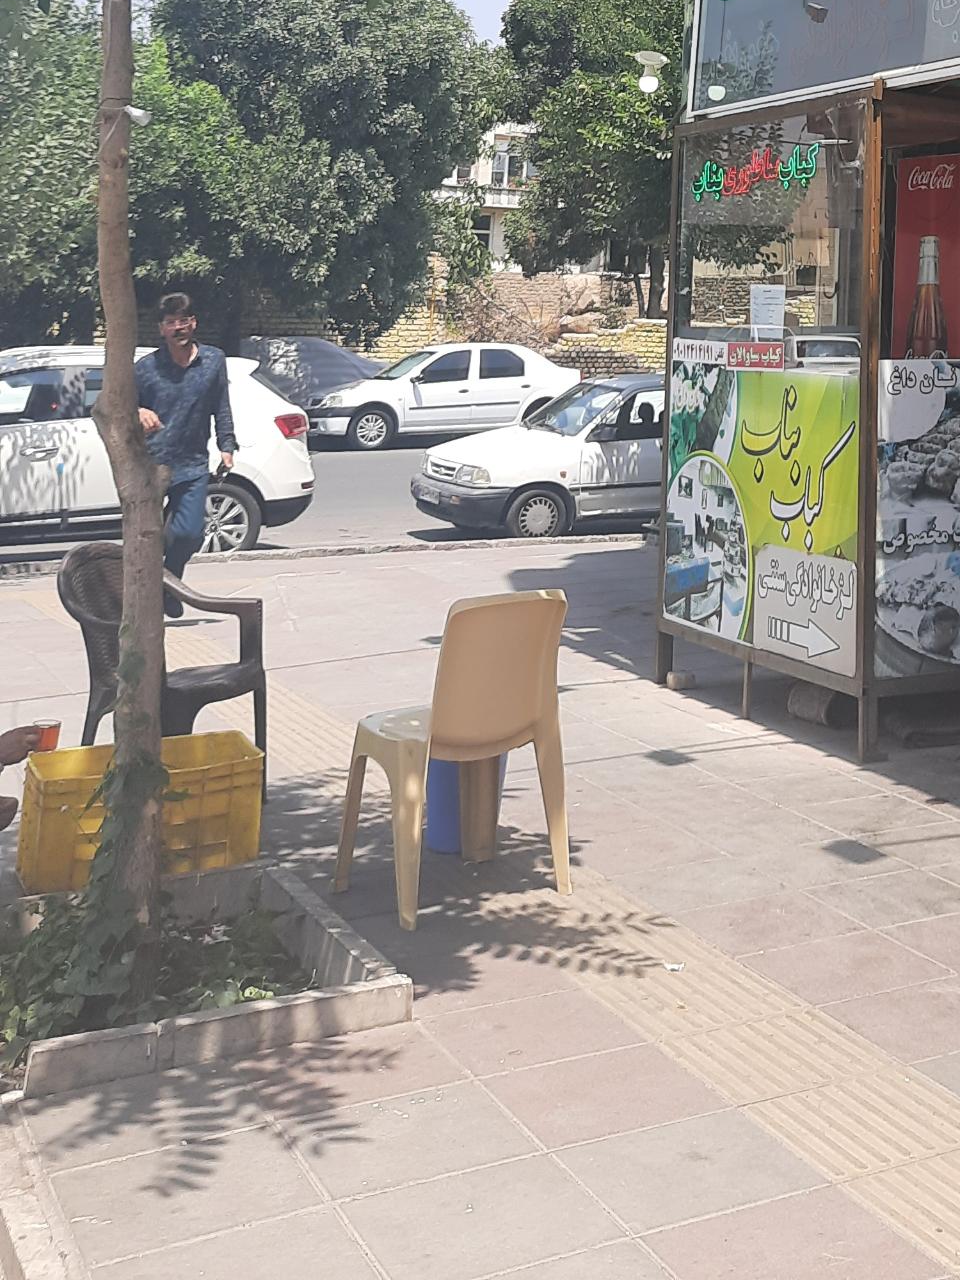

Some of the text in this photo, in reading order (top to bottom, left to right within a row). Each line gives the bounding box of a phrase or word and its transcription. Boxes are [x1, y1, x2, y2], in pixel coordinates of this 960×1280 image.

[691, 160, 725, 202] بناب
[778, 142, 820, 191] کباب
[729, 346, 783, 367] کباب ساوالان
[887, 365, 917, 395] داغ
[919, 366, 957, 394] نان
[741, 385, 801, 486] بناب
[770, 420, 856, 551] کباب
[883, 521, 950, 554] مخصوص
[758, 559, 787, 599] سنتی
[786, 561, 839, 613] خانوادگی
